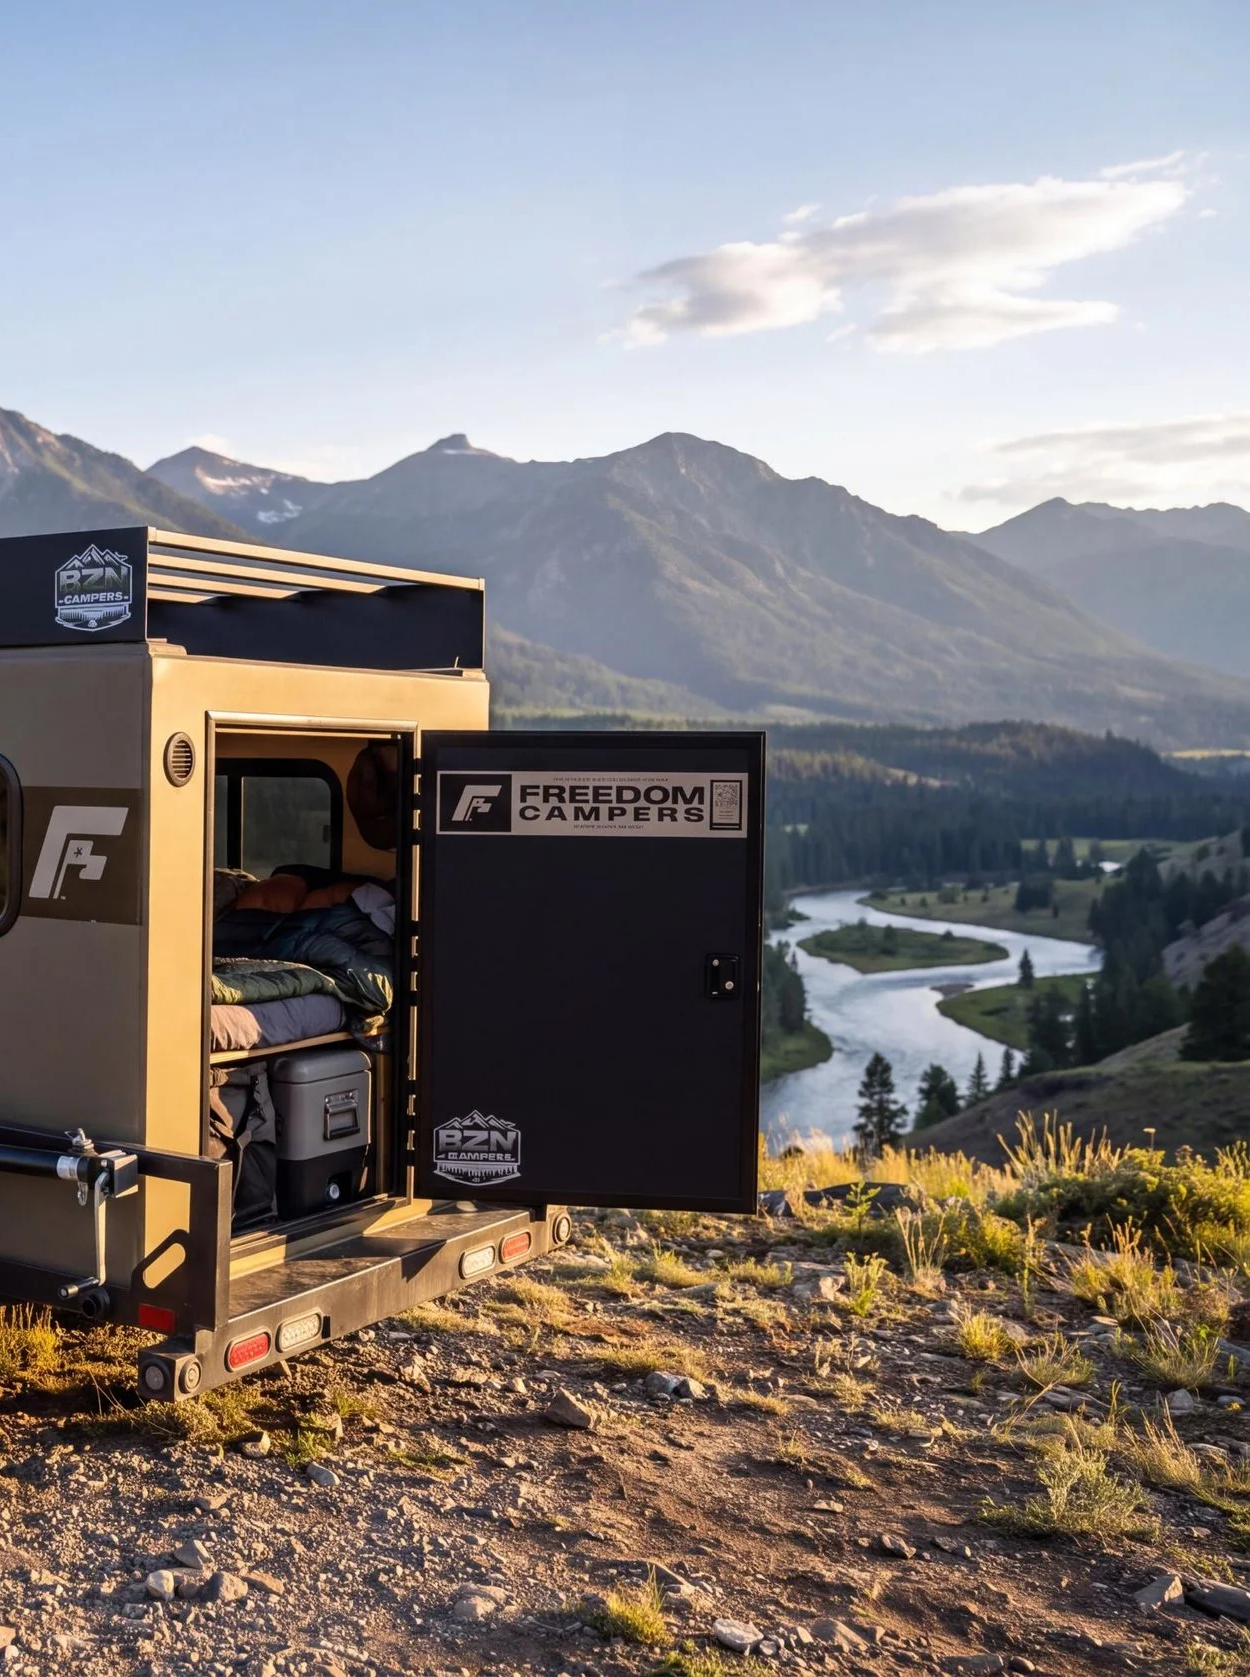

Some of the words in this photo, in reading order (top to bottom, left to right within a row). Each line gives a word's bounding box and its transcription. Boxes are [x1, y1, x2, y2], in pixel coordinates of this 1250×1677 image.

[59, 566, 129, 592] BZN
[519, 784, 705, 806] FREEDOM
[519, 805, 705, 823] CAMPERS
[438, 1129, 517, 1152] BZN
